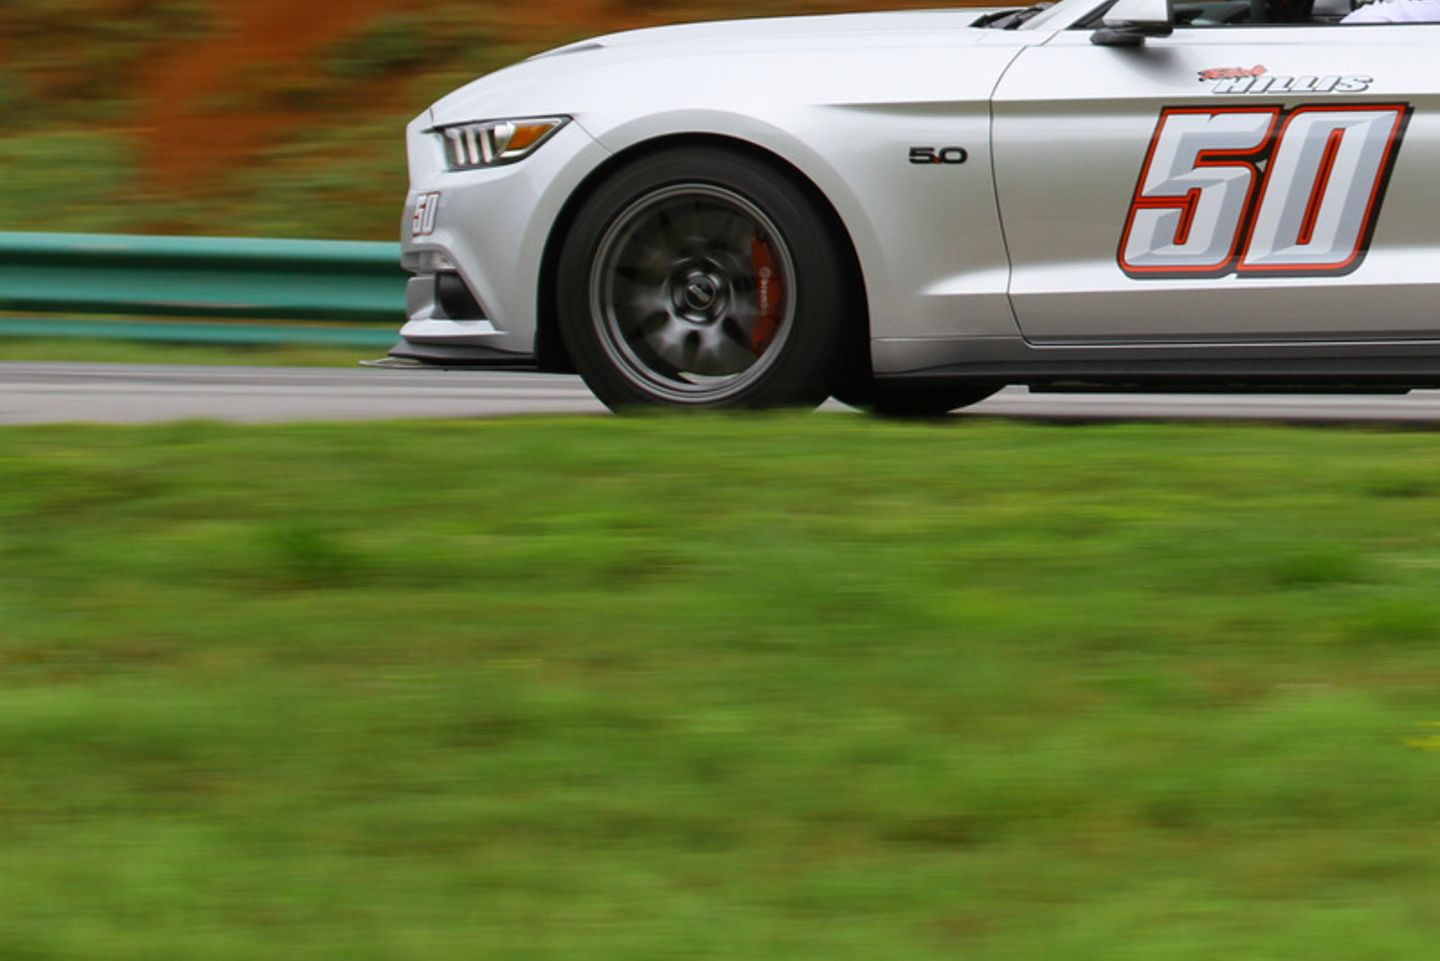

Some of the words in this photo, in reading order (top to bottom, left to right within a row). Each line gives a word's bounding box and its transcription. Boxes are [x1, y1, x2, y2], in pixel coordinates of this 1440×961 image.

[908, 146, 968, 164] 5.0
[411, 191, 441, 237] 50
[1116, 103, 1415, 280] 50
